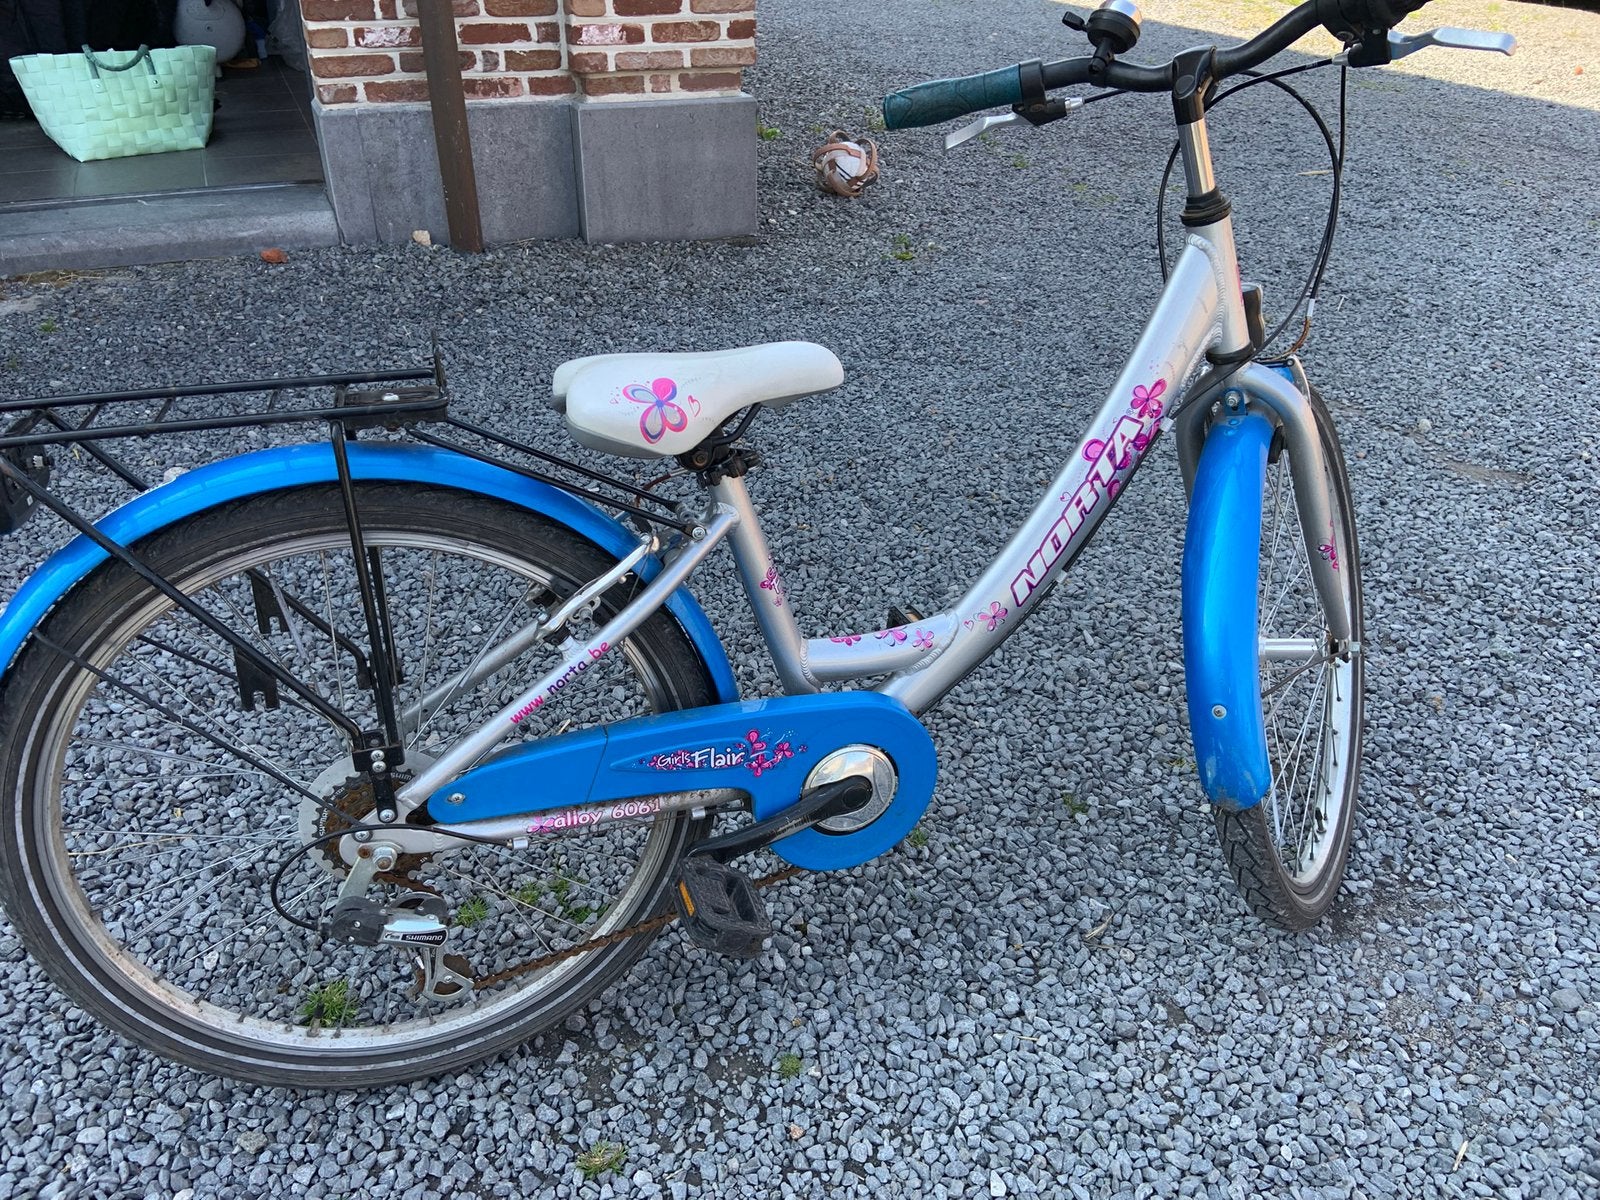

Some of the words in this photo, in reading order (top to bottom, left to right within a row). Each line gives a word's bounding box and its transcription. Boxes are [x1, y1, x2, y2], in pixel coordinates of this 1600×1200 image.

[1010, 414, 1144, 608] NORTA
[690, 747, 746, 769] Flair
[553, 810, 603, 828] alloy
[612, 798, 661, 819] 6061
